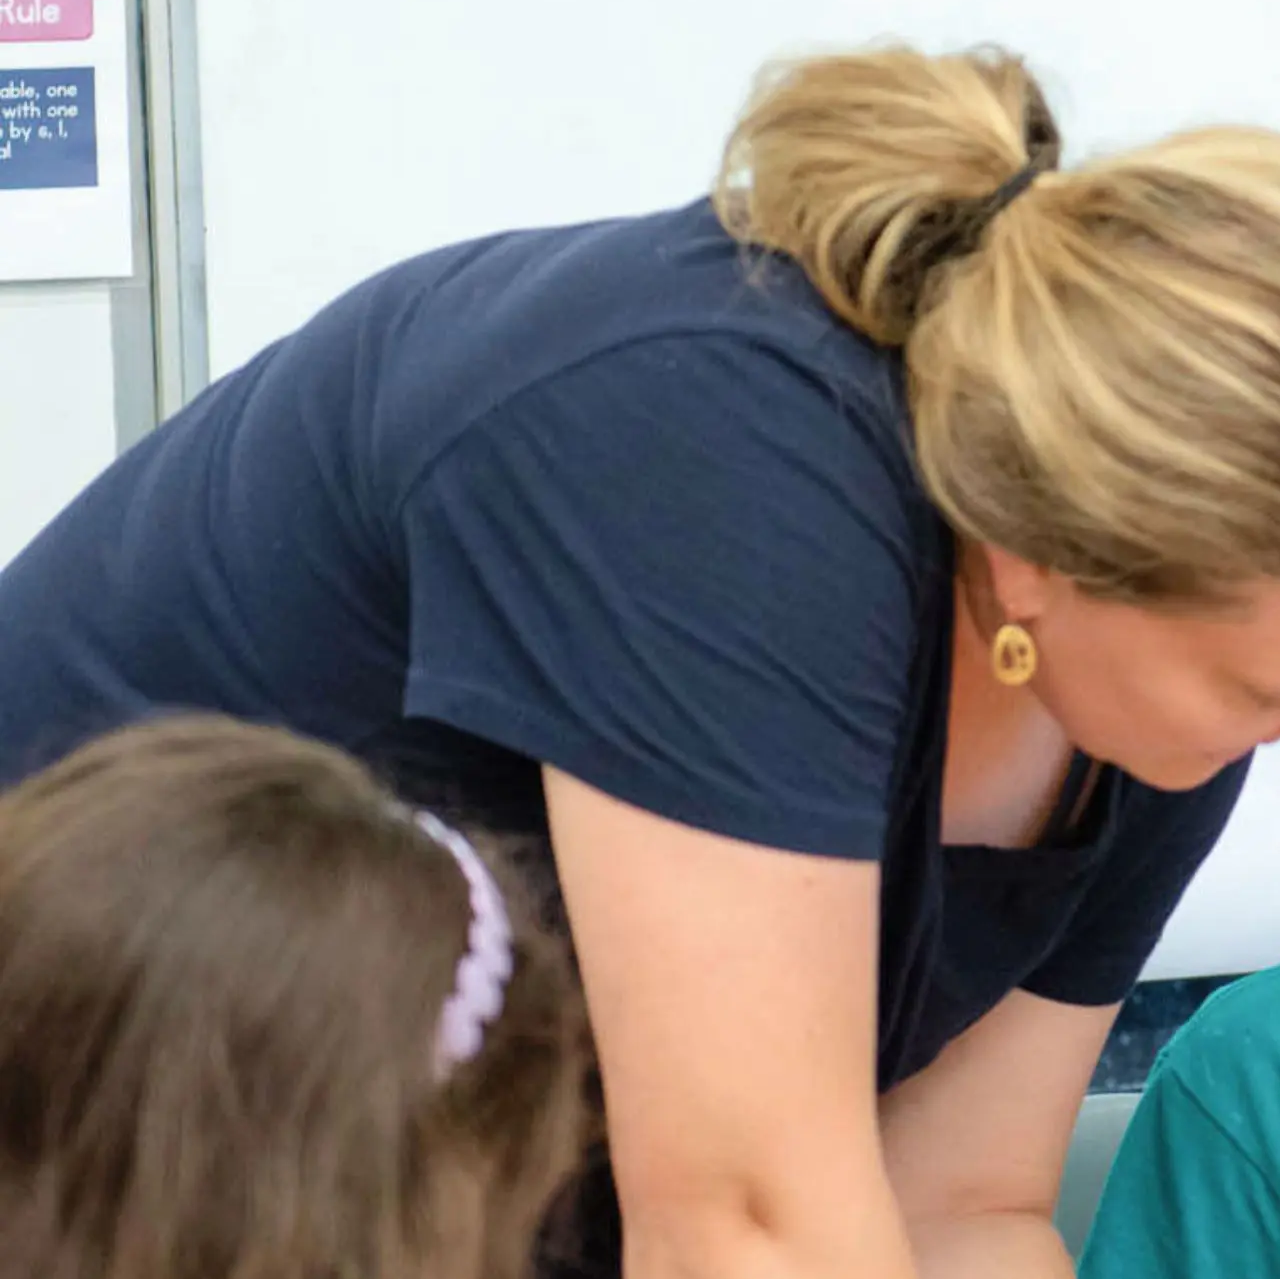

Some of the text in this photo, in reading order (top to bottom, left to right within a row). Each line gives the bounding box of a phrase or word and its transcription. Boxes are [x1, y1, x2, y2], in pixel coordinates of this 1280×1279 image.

[46, 85, 77, 98] one
[46, 105, 78, 118] one
[10, 121, 32, 144] by
